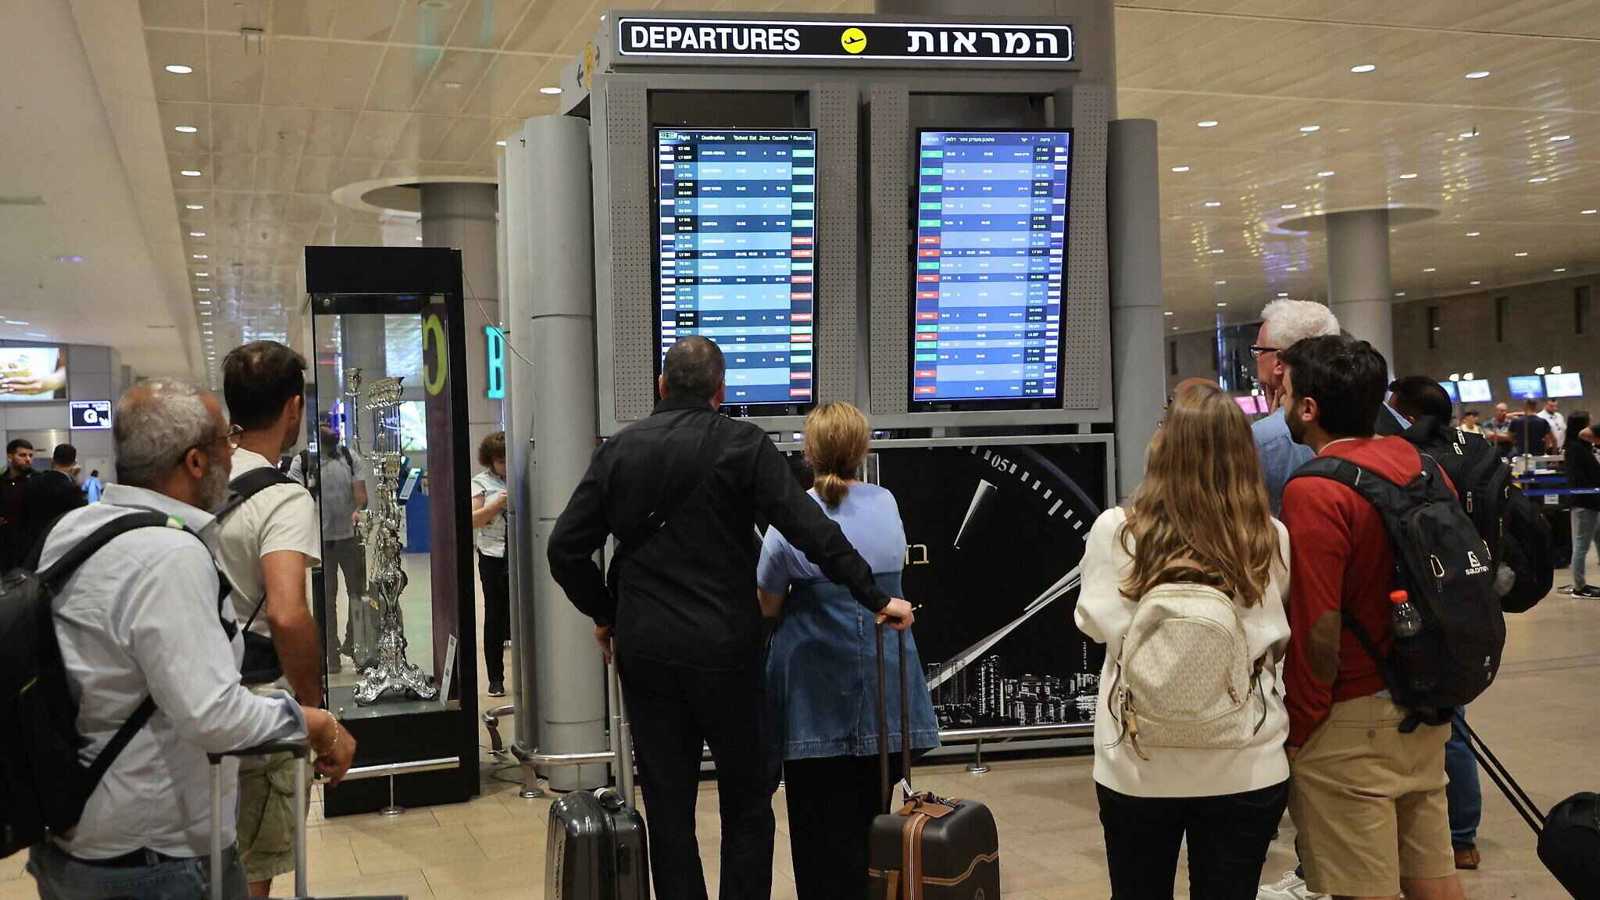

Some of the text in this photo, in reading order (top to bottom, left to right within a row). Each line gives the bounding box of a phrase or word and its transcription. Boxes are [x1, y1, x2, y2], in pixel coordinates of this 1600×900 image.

[630, 26, 801, 51] DEPARTURES
[907, 30, 1059, 54] המראות
[484, 325, 505, 400] B
[83, 408, 98, 424] G
[991, 454, 1010, 472] 05
